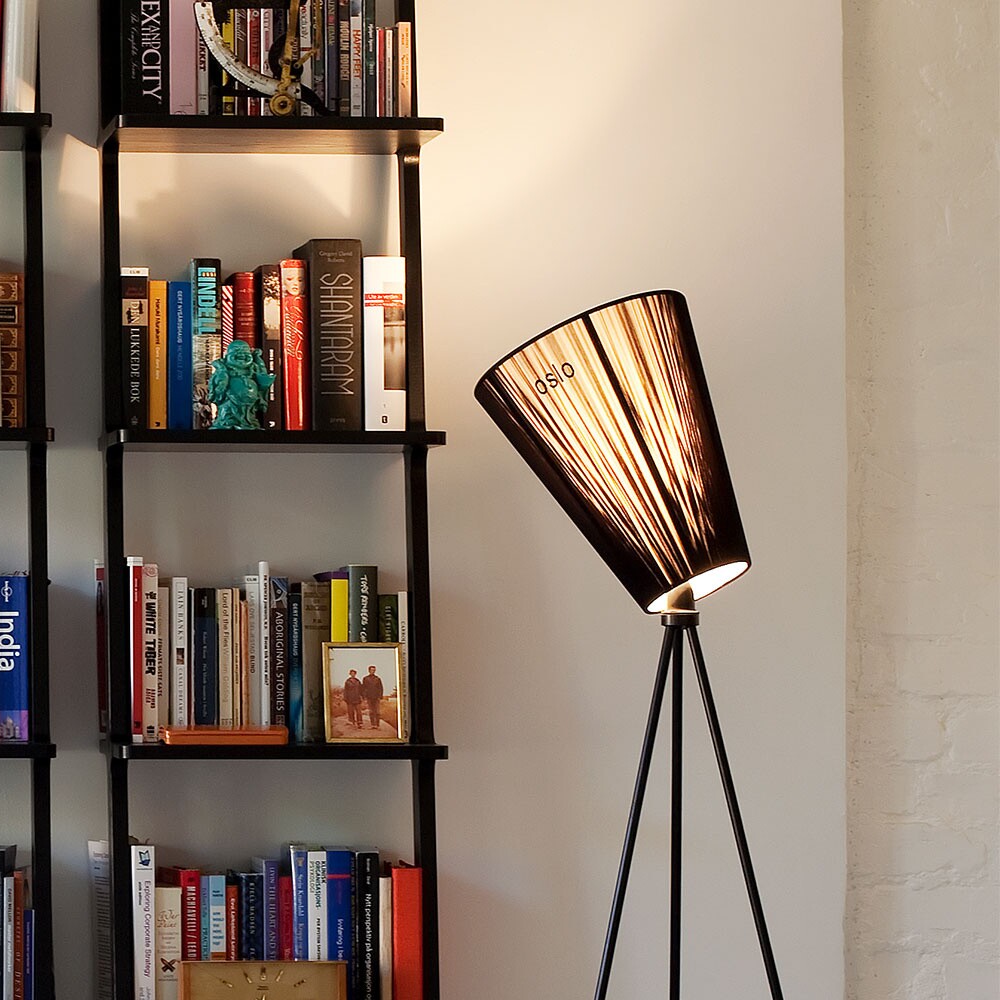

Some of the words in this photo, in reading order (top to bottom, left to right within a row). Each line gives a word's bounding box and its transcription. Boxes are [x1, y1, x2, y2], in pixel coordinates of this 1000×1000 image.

[141, 27, 151, 48] THE
[151, 25, 161, 49] AND
[340, 21, 350, 51] MOULIN
[353, 30, 361, 57] HAPPY
[141, 48, 162, 99] CITY
[353, 59, 361, 79] FEET
[130, 302, 141, 326] DEN
[198, 268, 217, 337] LINDELL
[155, 318, 163, 346] Murakami
[319, 273, 355, 396] SHANTARAM
[130, 328, 141, 378] LUKKEDE
[130, 381, 141, 404] BOK
[534, 361, 576, 395] oslo
[145, 602, 157, 634] WHITE
[276, 674, 284, 711] STORIES
[143, 881, 151, 911] Exploring
[187, 886, 197, 932] MACHIAVELLI
[143, 914, 151, 948] Corporate
[336, 919, 344, 945] Innføring
[364, 909, 372, 941] perspektiv
[364, 943, 373, 952] på
[143, 949, 151, 977] Strategy
[364, 953, 372, 992] organisasjon
